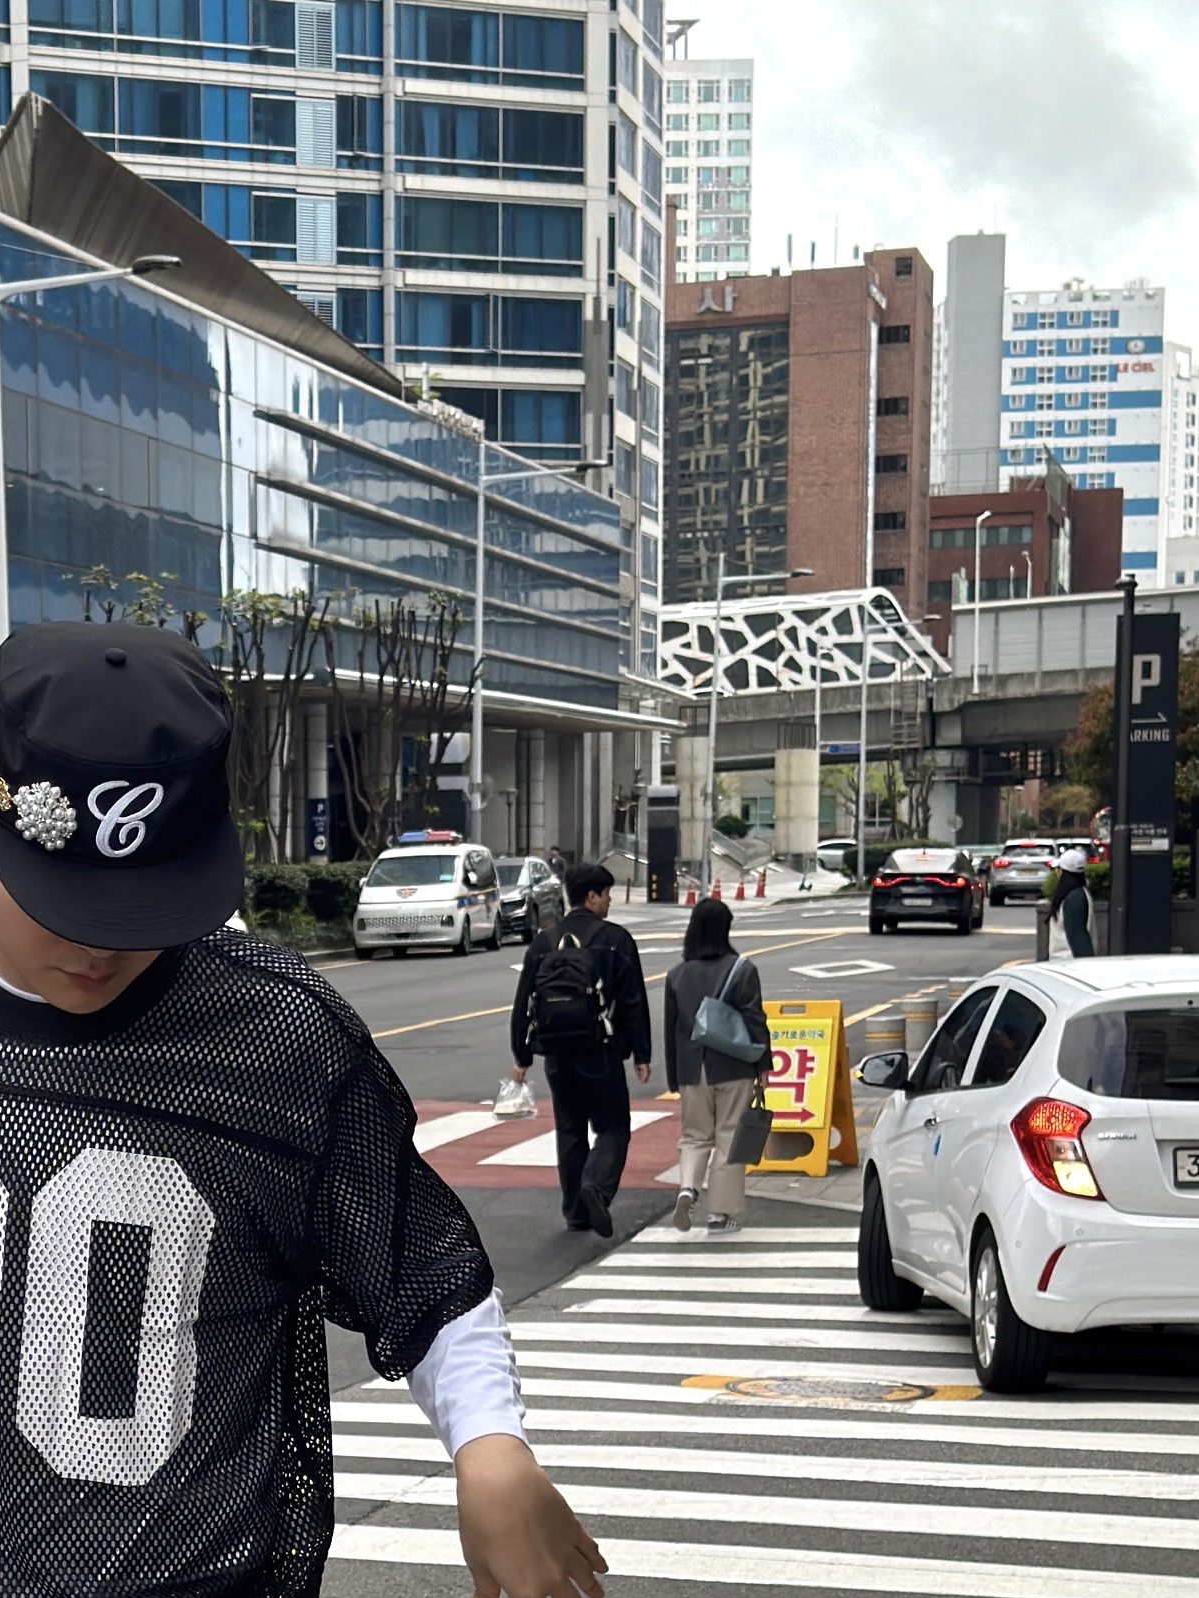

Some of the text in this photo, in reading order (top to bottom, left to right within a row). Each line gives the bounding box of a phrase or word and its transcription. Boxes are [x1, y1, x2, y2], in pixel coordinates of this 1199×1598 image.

[1131, 653, 1161, 704] P
[1130, 729, 1170, 742] RKING
[87, 780, 164, 858] C
